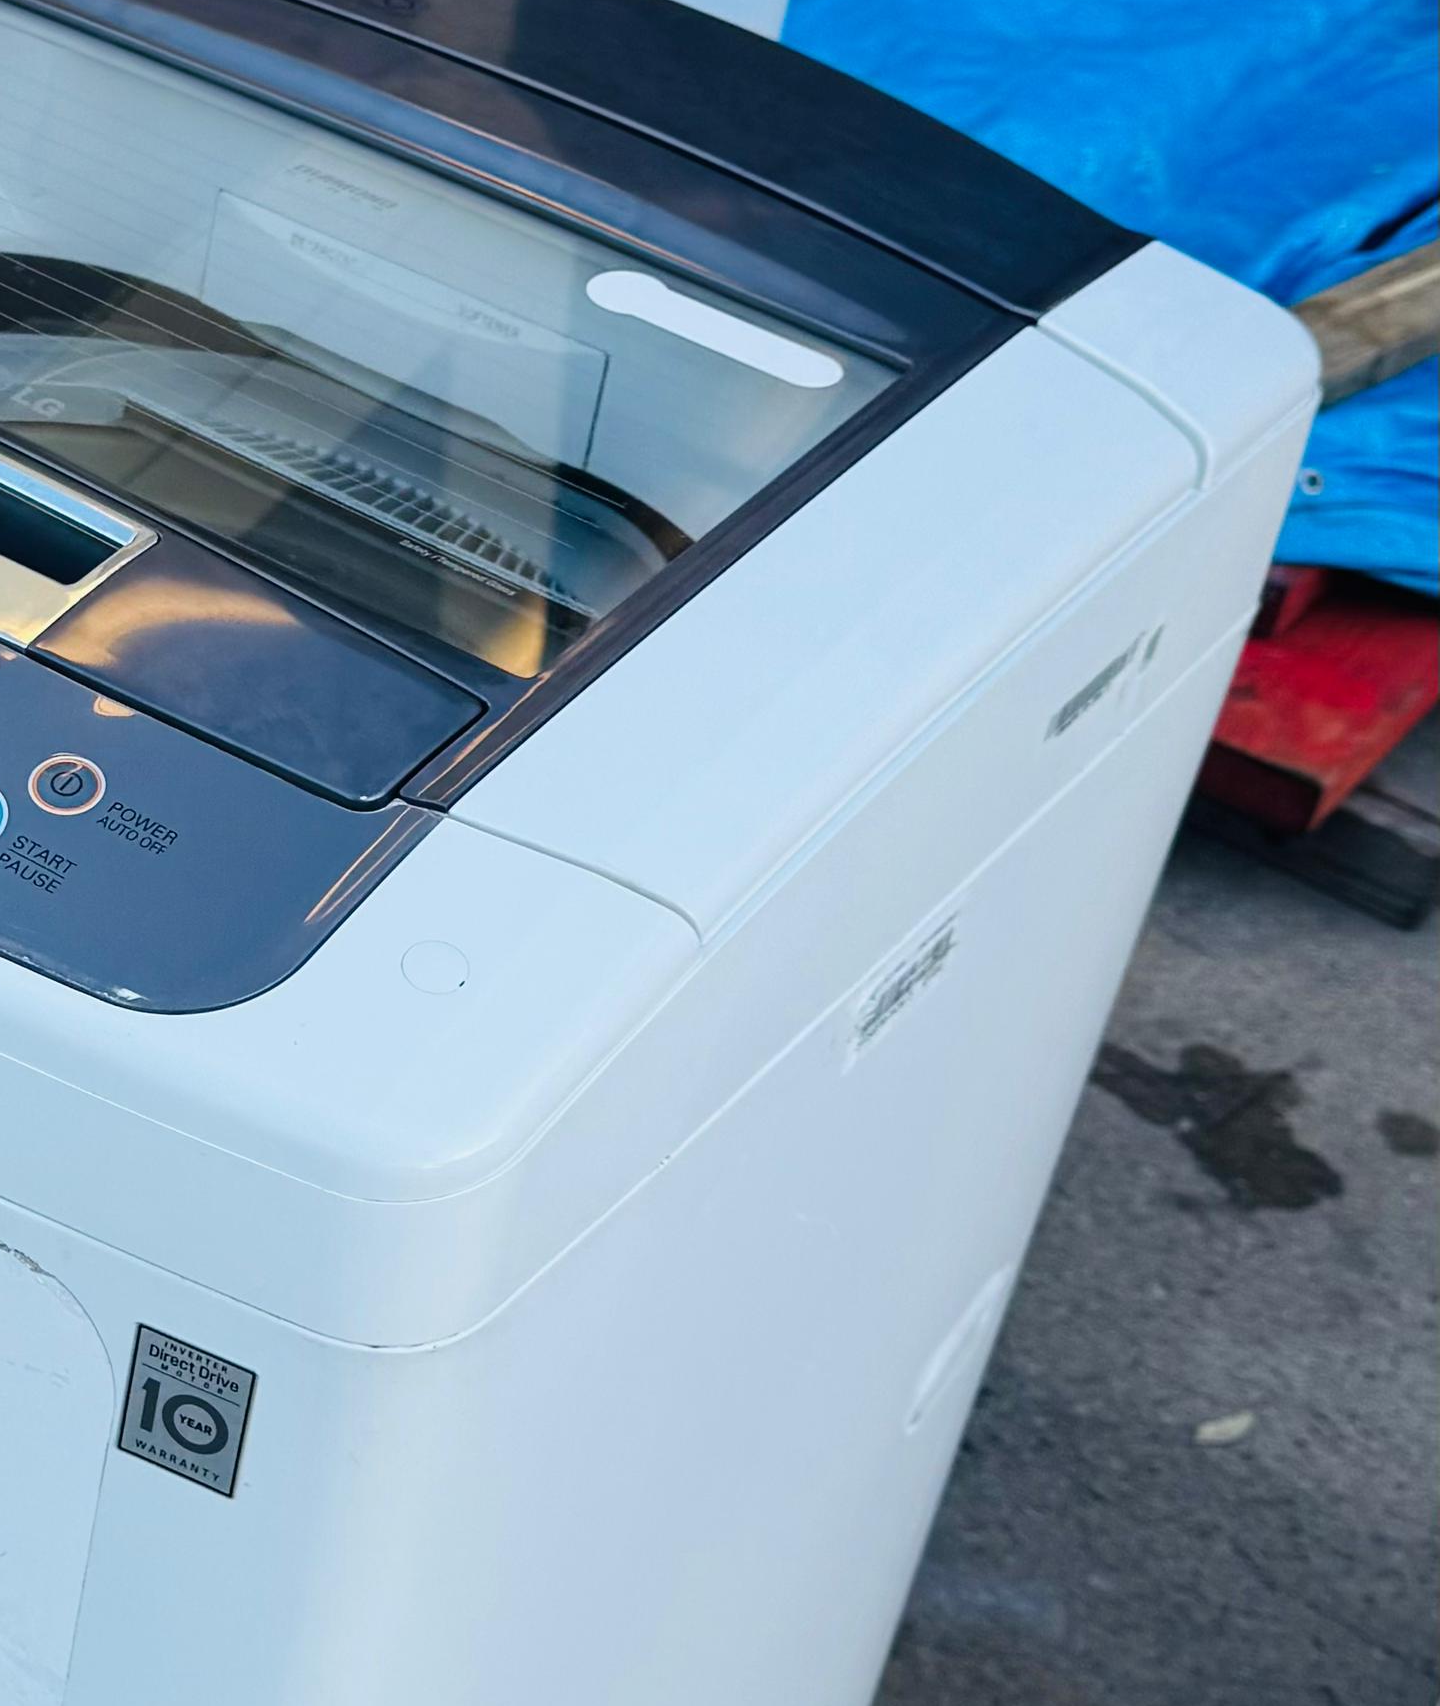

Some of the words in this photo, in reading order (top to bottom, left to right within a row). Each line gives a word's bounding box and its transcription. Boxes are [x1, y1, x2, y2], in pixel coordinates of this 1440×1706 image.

[96, 815, 139, 842] AUTO
[139, 834, 168, 855] OFF
[106, 801, 179, 845] POWER
[12, 835, 79, 875] START
[148, 1343, 196, 1375] Direct
[198, 1365, 240, 1393] Drive
[163, 1341, 229, 1374] INVERTER
[160, 1362, 224, 1395] MOTOR
[139, 1376, 229, 1456] 10
[178, 1413, 213, 1436] YEAR
[135, 1437, 221, 1483] WARRANTY
